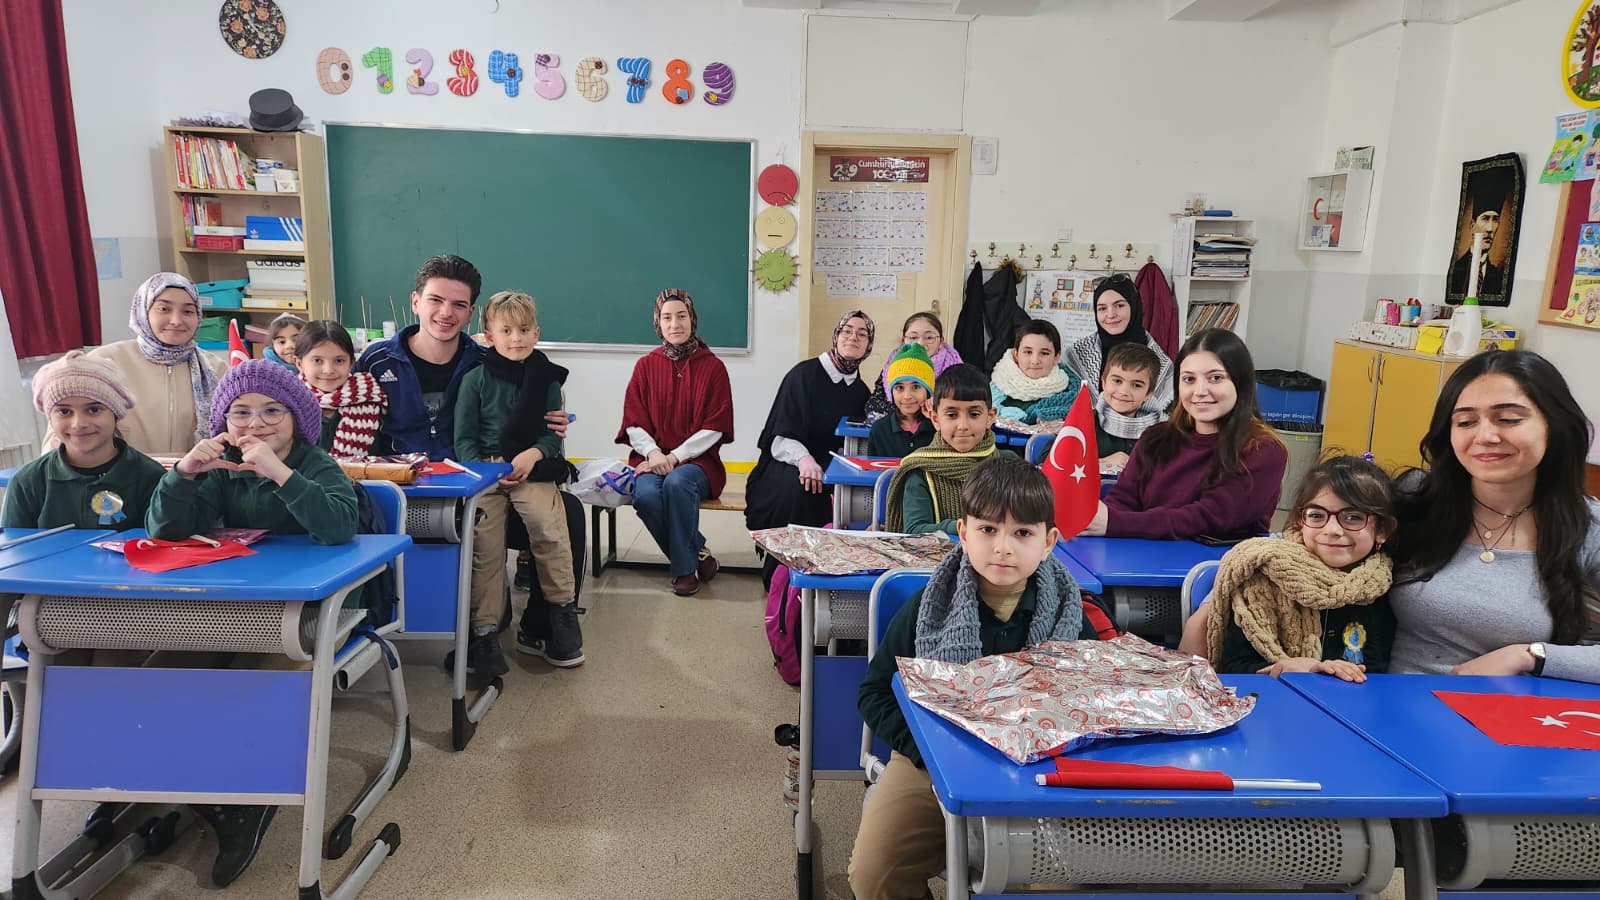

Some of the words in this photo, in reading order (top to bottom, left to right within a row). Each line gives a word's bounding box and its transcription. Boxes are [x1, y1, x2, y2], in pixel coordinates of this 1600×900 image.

[316, 47, 353, 95] 0
[361, 46, 393, 95] 1
[405, 48, 439, 96] 2
[447, 48, 478, 97] 3
[488, 49, 523, 98] 4
[533, 53, 567, 100] 5
[575, 56, 608, 102] 6
[616, 57, 651, 104] 7
[661, 58, 695, 105] 8
[702, 61, 736, 106] 9
